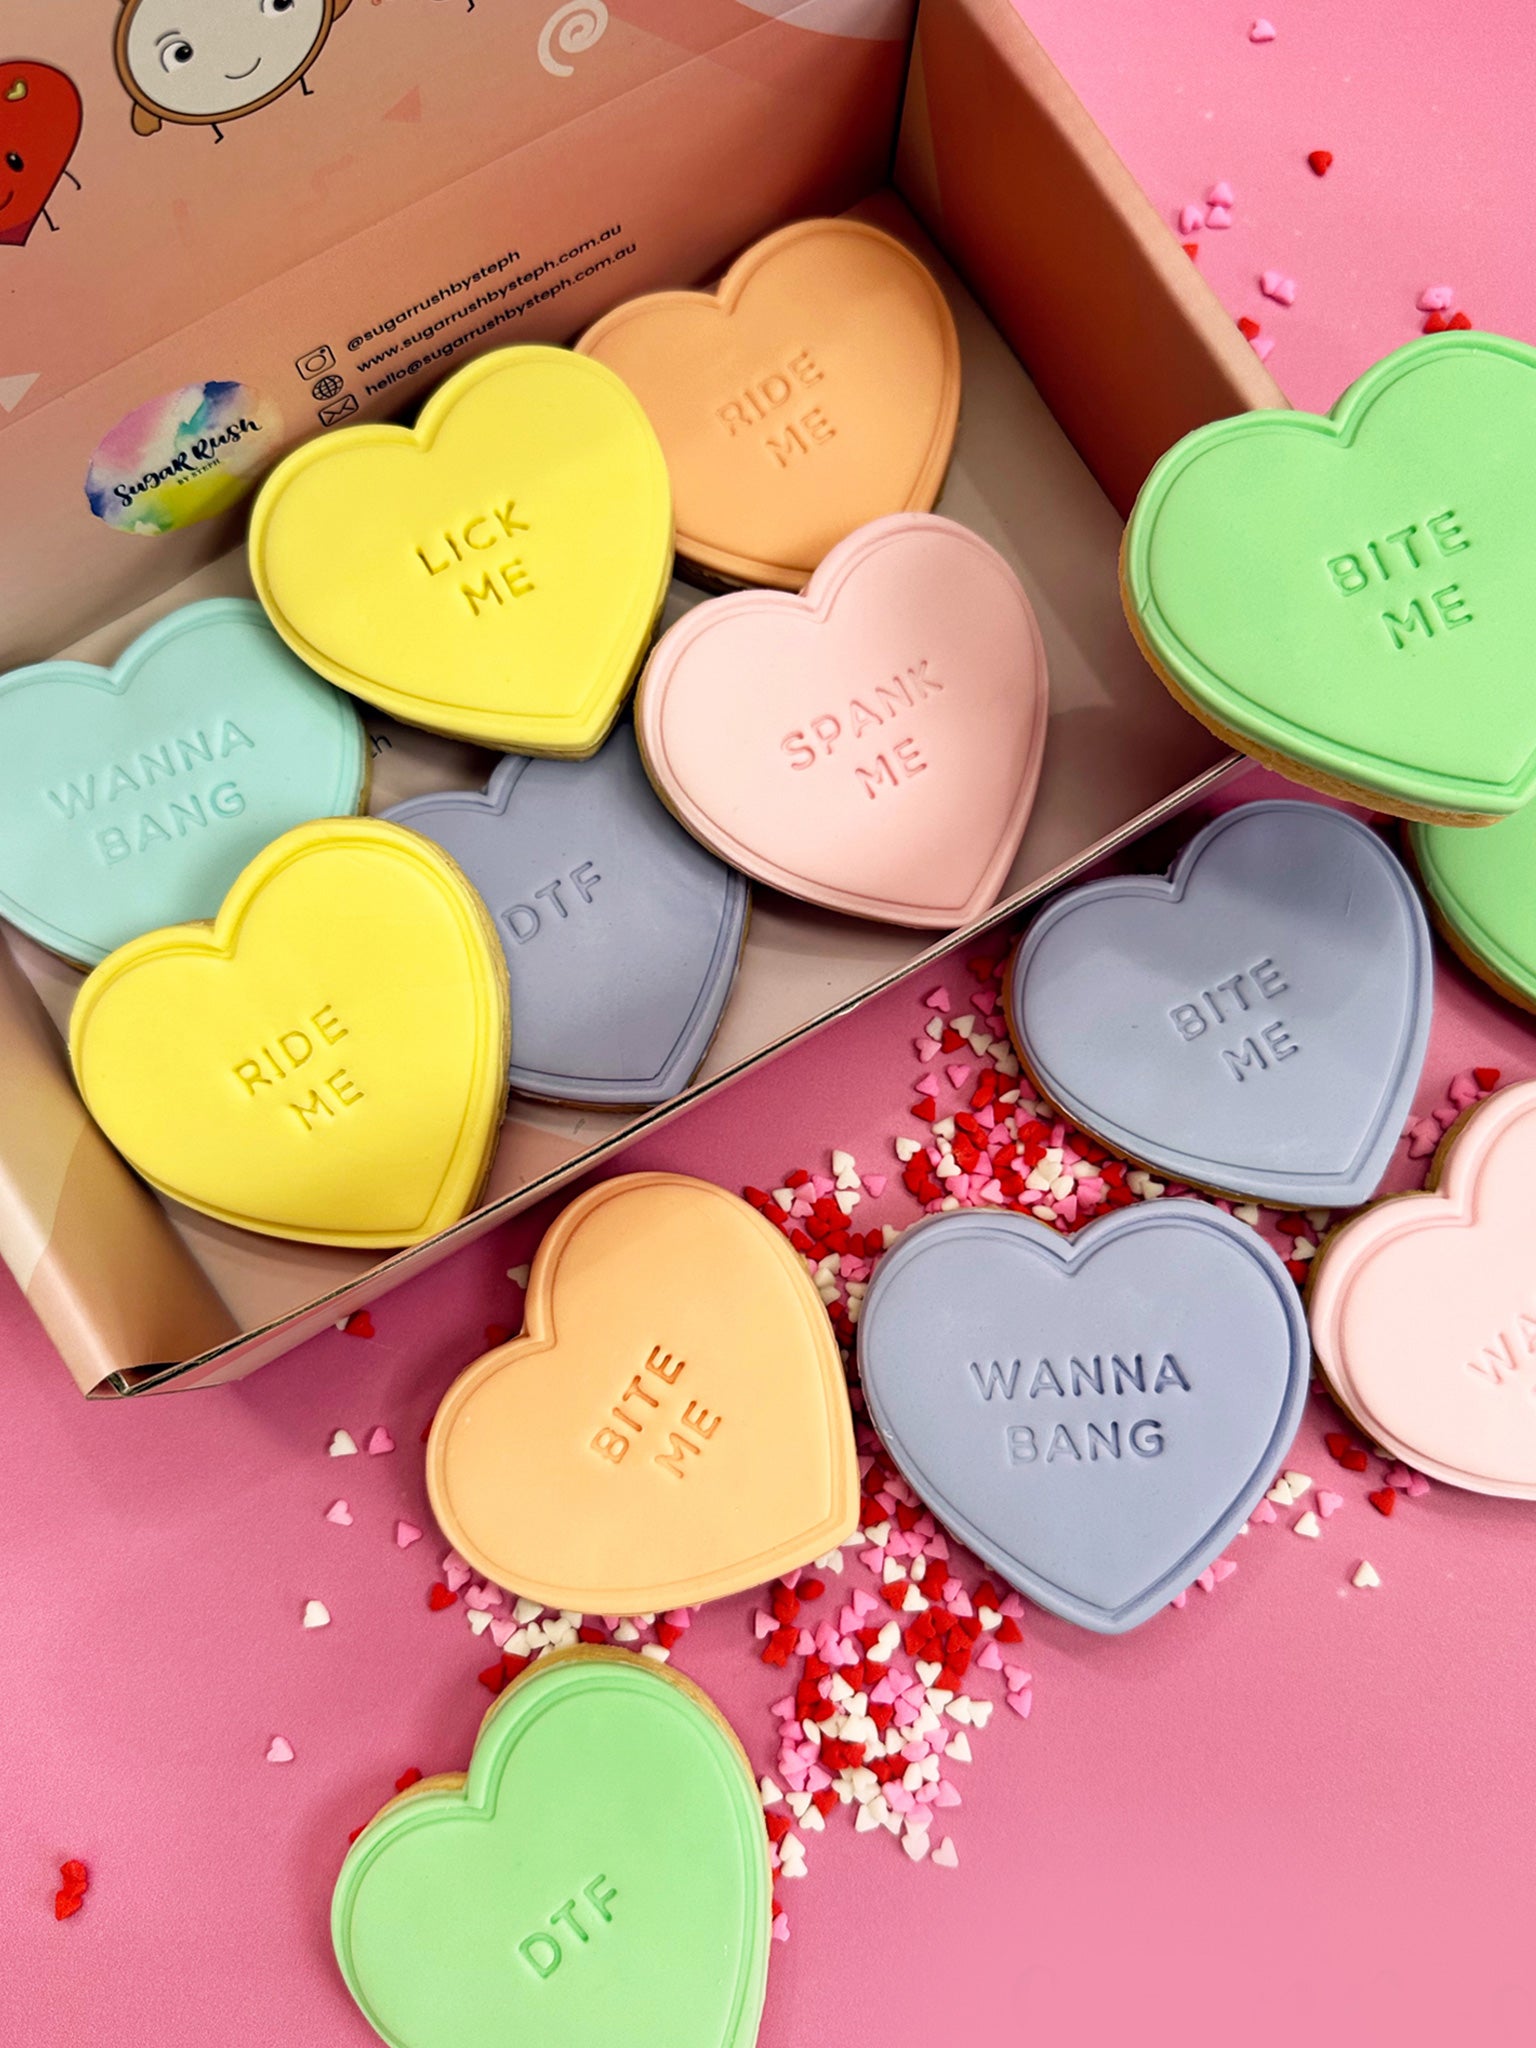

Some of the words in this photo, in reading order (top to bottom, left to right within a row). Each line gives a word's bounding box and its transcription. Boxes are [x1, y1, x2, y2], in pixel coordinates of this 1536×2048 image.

[347, 250, 521, 352] @sugarrushbysteph
[356, 224, 622, 373] www.sugarrushbysteph.com.au
[365, 242, 637, 396] hello@sugarrushbysteph.com.au
[715, 351, 825, 437] RIDE
[177, 475, 190, 485] BY
[191, 458, 221, 479] STEPH
[764, 407, 837, 468] ME
[415, 501, 530, 576] LICK
[1327, 510, 1470, 597] BITE
[460, 559, 535, 617] ME
[1382, 584, 1473, 650] ME
[781, 660, 943, 771] SPANK
[49, 720, 255, 820] WANNA
[855, 737, 927, 800] ME
[97, 781, 246, 866] BANG
[501, 860, 601, 945] DTF
[1169, 958, 1289, 1042] BITE
[232, 1004, 349, 1097] RIDE
[1221, 1021, 1299, 1082] ME
[289, 1068, 365, 1131] ME
[590, 1345, 686, 1464] BITE
[969, 1353, 1192, 1401] WANNA
[654, 1400, 722, 1479] ME
[1006, 1418, 1164, 1465] BANG
[518, 1874, 618, 1979] DTF
